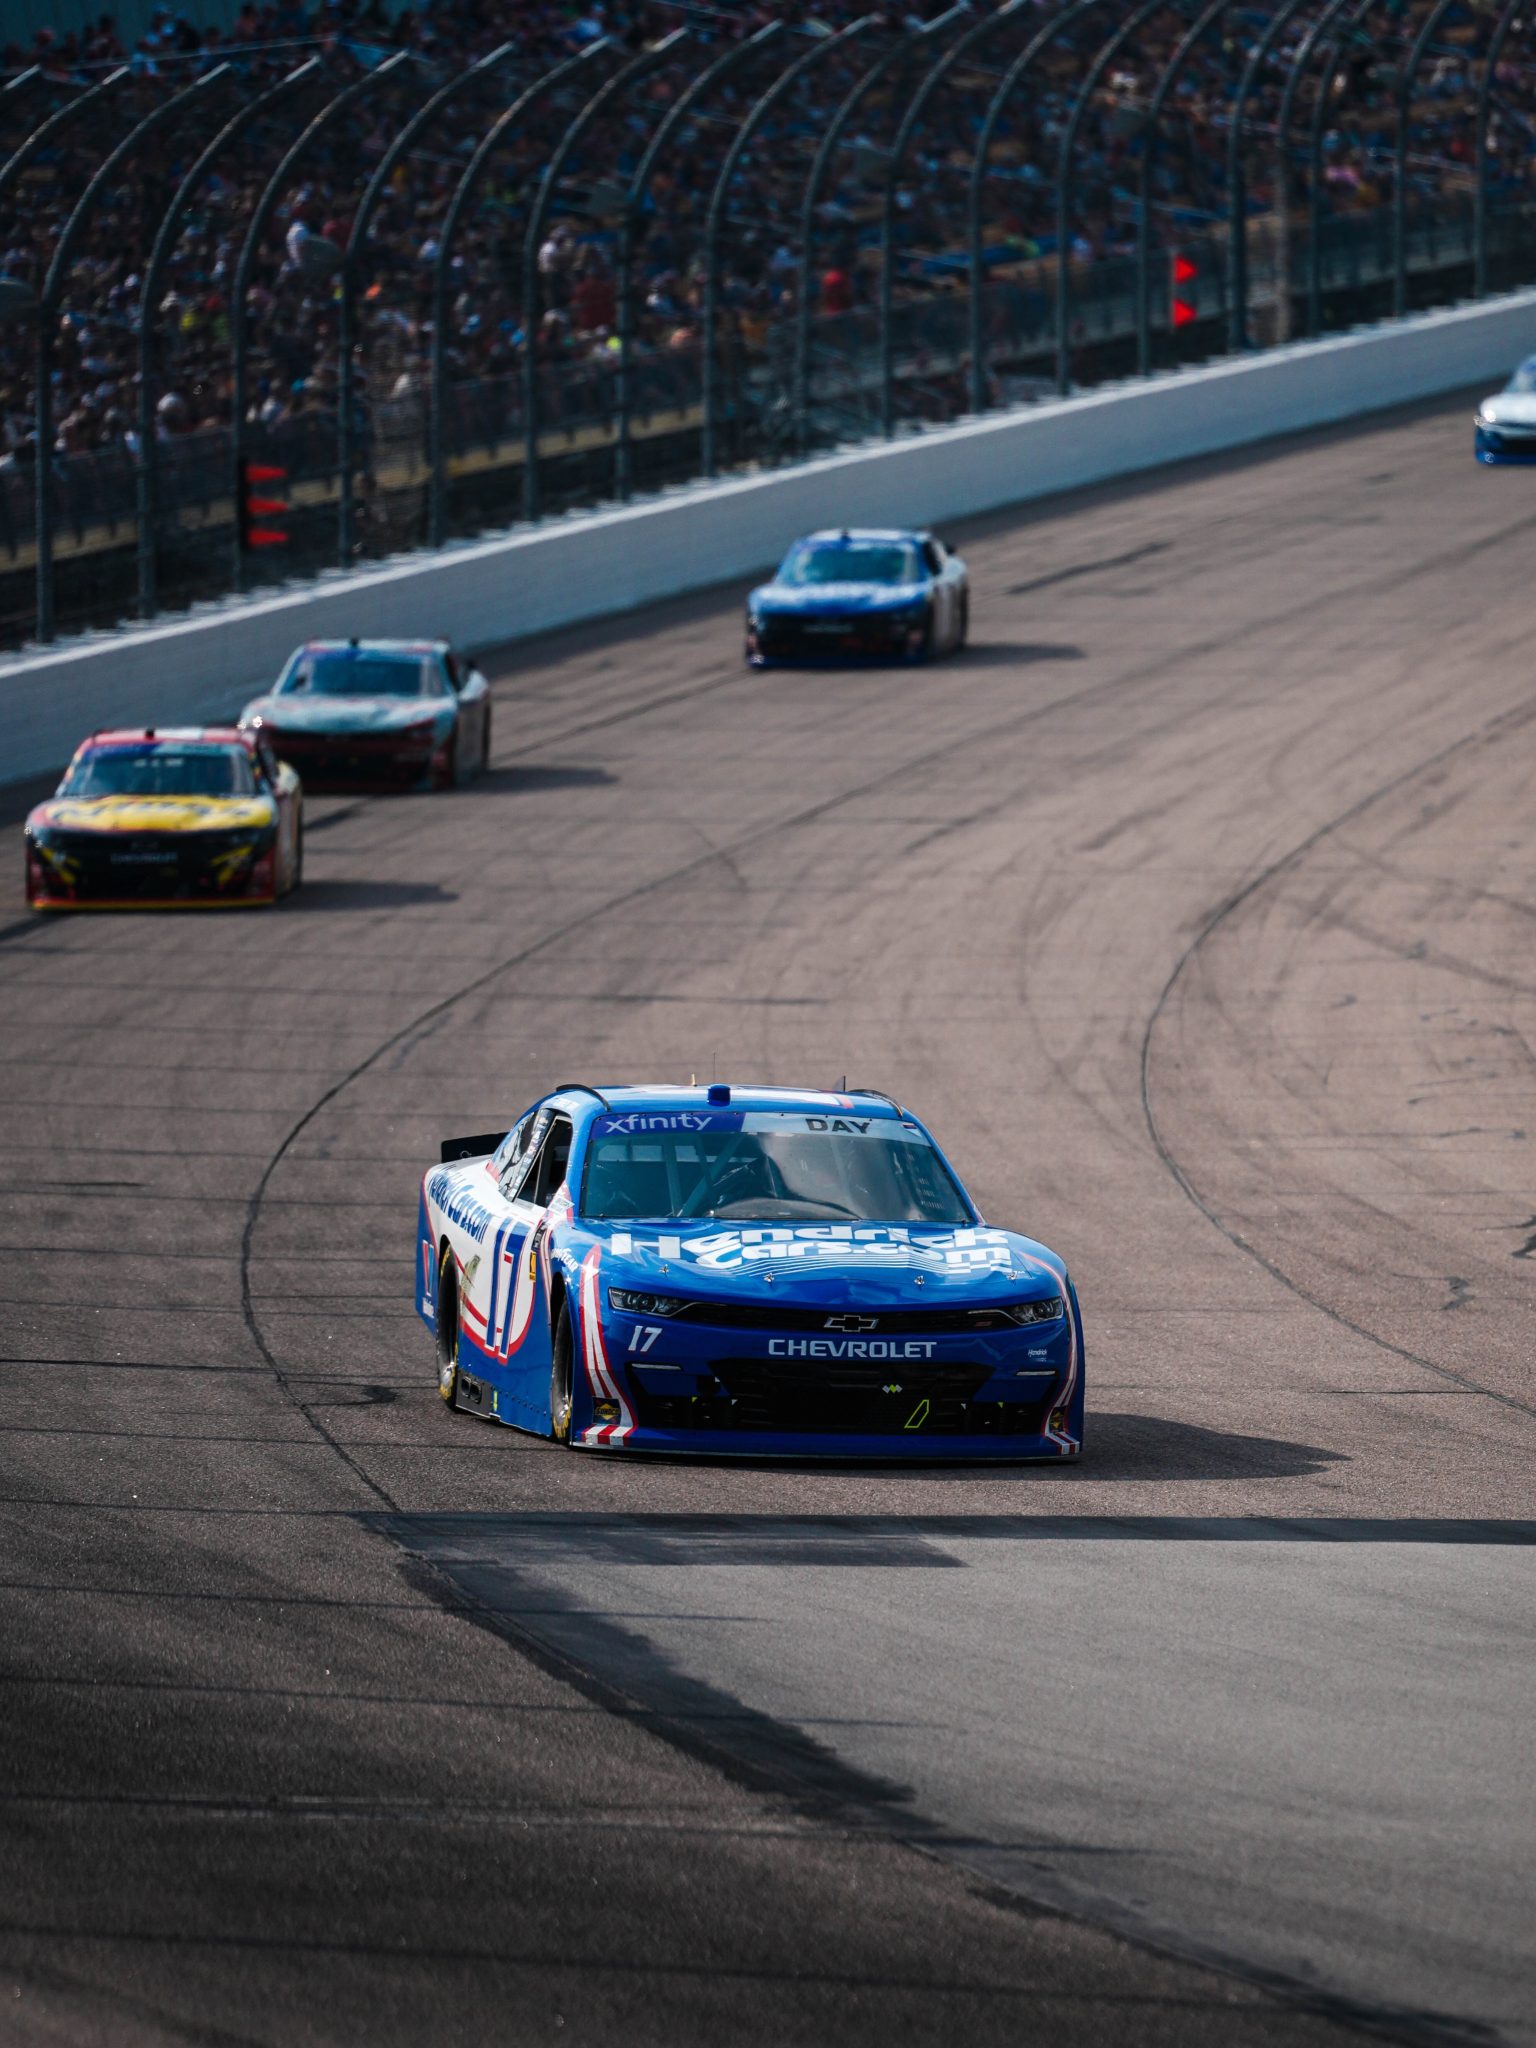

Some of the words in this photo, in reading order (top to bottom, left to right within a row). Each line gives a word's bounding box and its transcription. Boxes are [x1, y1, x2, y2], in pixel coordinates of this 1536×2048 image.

[605, 1113, 712, 1134] xfinity
[805, 1117, 870, 1134] DAY
[628, 1325, 663, 1352] 17
[768, 1339, 937, 1358] CHEVROLET
